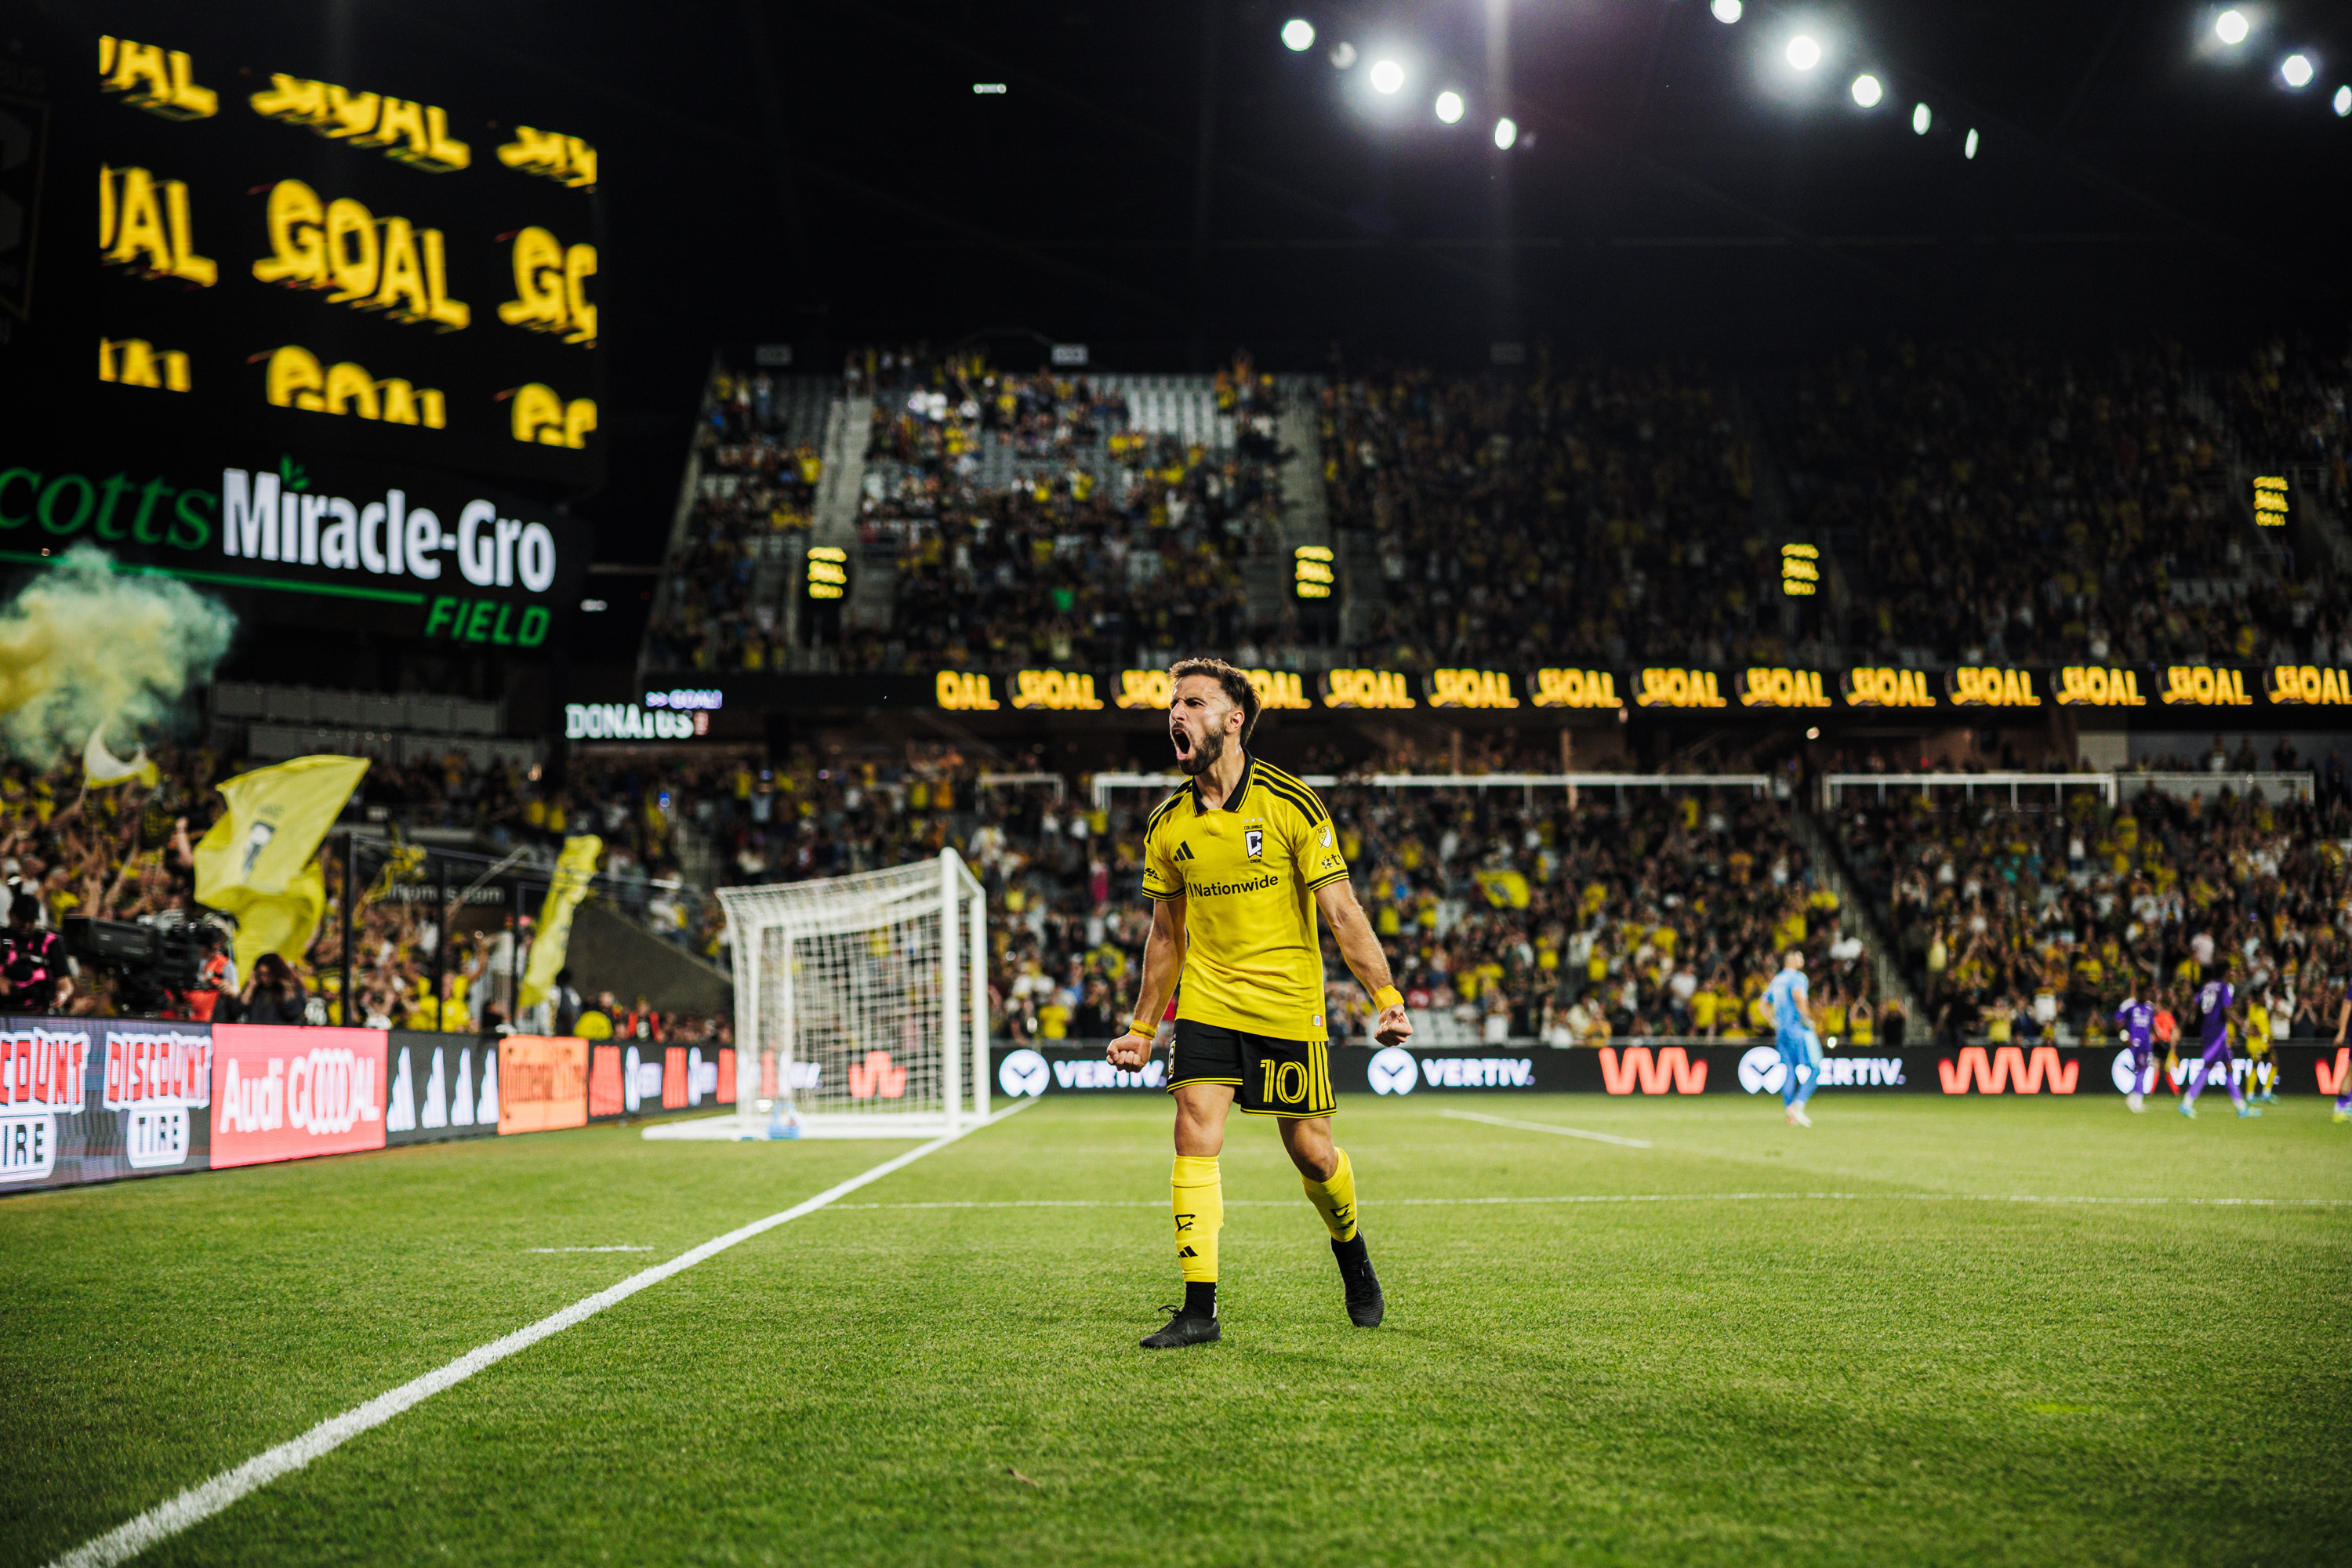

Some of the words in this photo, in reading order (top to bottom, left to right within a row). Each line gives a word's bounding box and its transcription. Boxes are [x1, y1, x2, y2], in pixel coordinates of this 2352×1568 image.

[99, 166, 217, 287] AL
[252, 180, 470, 328] GOAL
[223, 468, 556, 592] Miracle-Gro
[425, 596, 551, 647] FIELD
[1192, 874, 1279, 898] Nationwide
[103, 1030, 212, 1111] DISCOUNT
[220, 1058, 284, 1134] Audi
[1259, 1058, 1309, 1105] 10
[1421, 1058, 1533, 1087] VERTIV
[138, 1115, 180, 1156] TIRE
